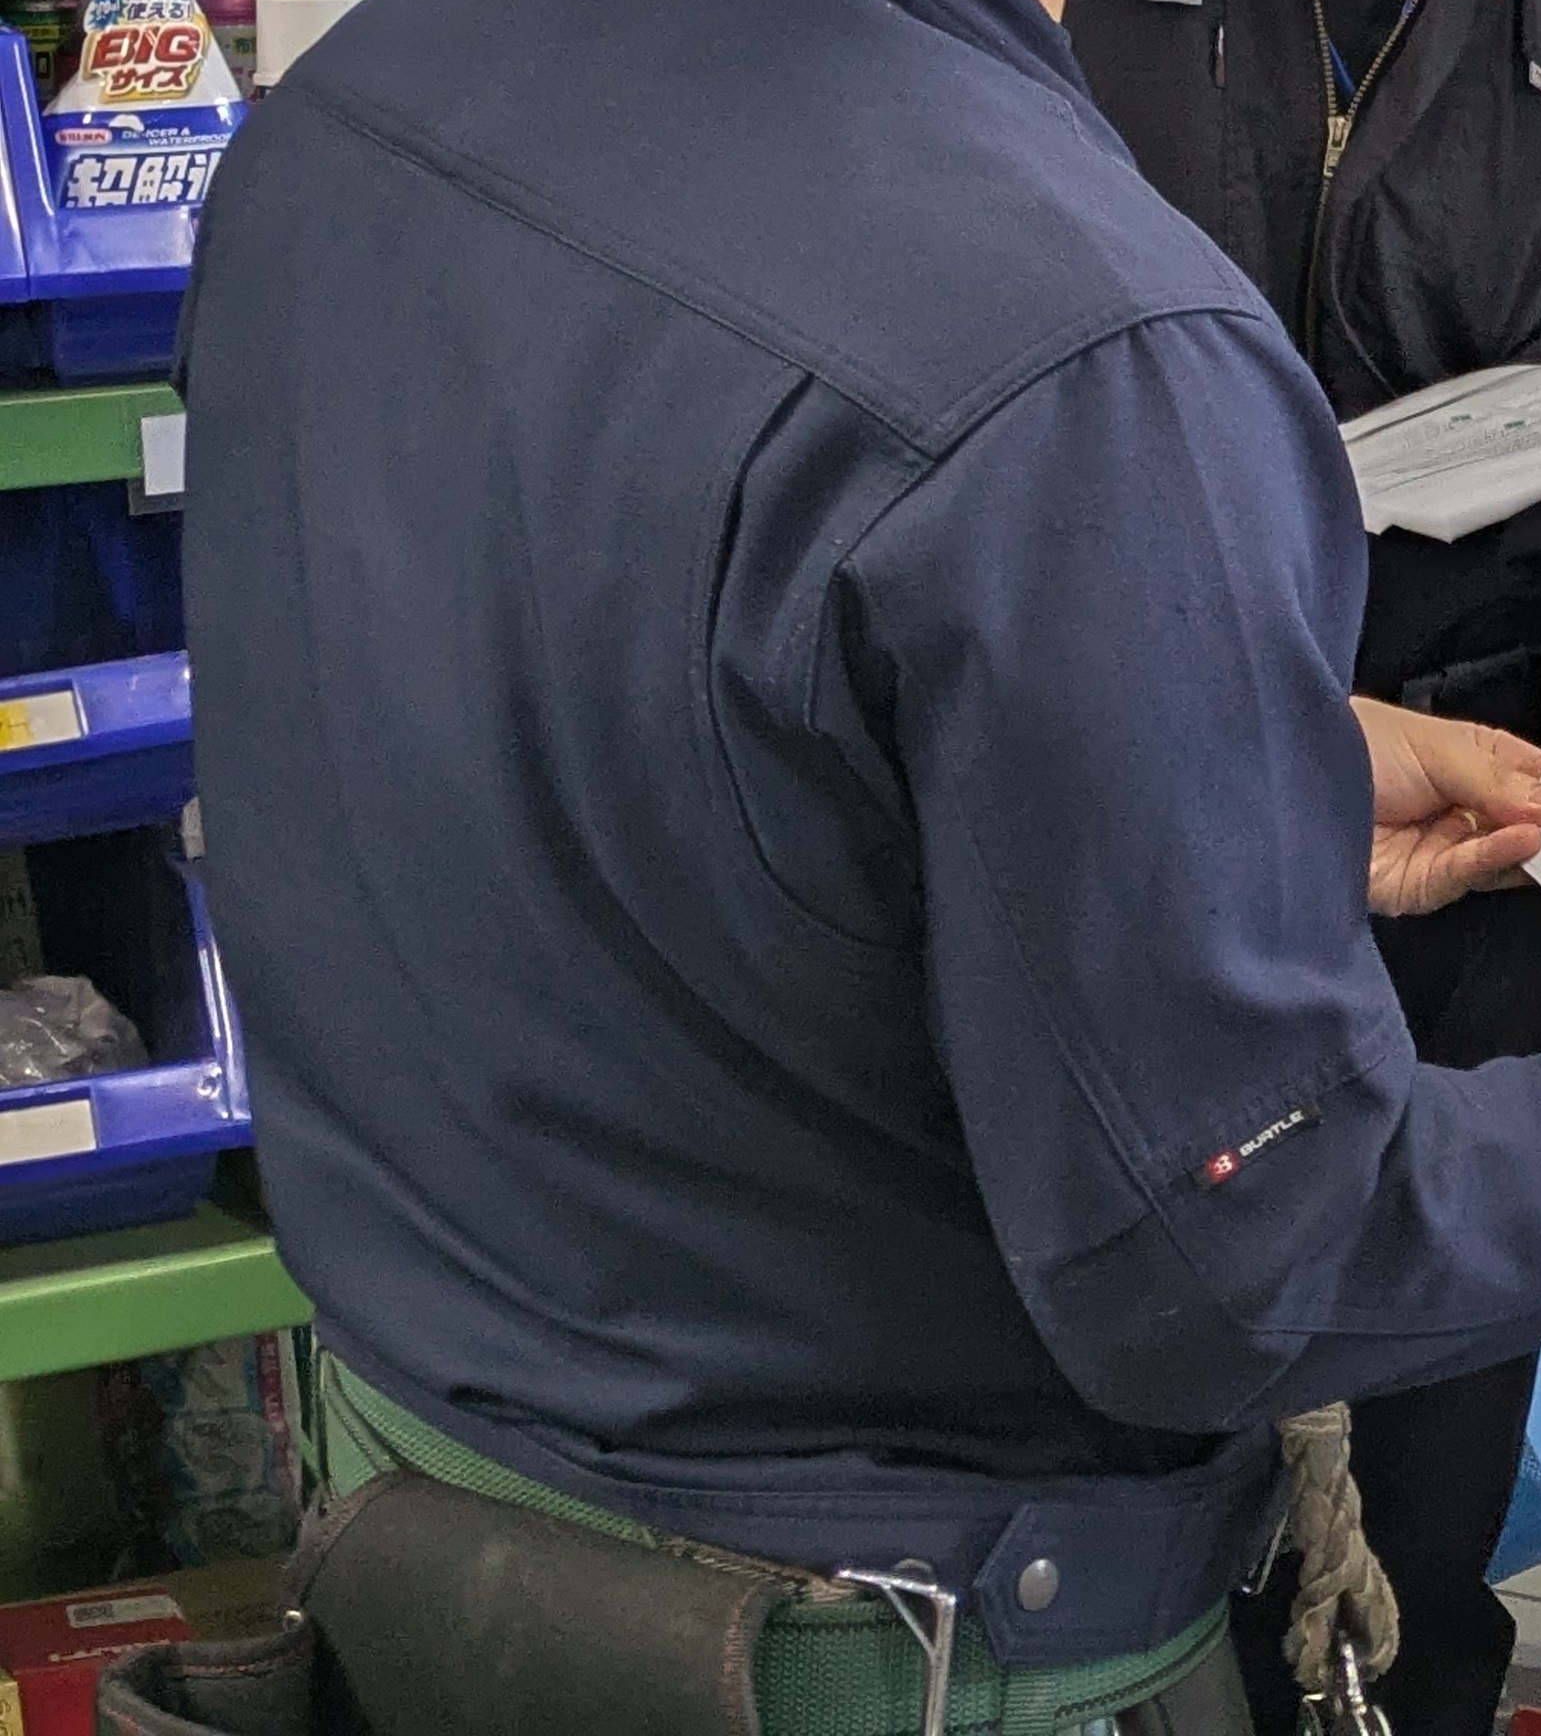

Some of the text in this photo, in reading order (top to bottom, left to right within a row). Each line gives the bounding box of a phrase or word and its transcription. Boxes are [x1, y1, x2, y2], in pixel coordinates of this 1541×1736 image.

[91, 25, 201, 70] BIG
[109, 65, 188, 92] サイズ
